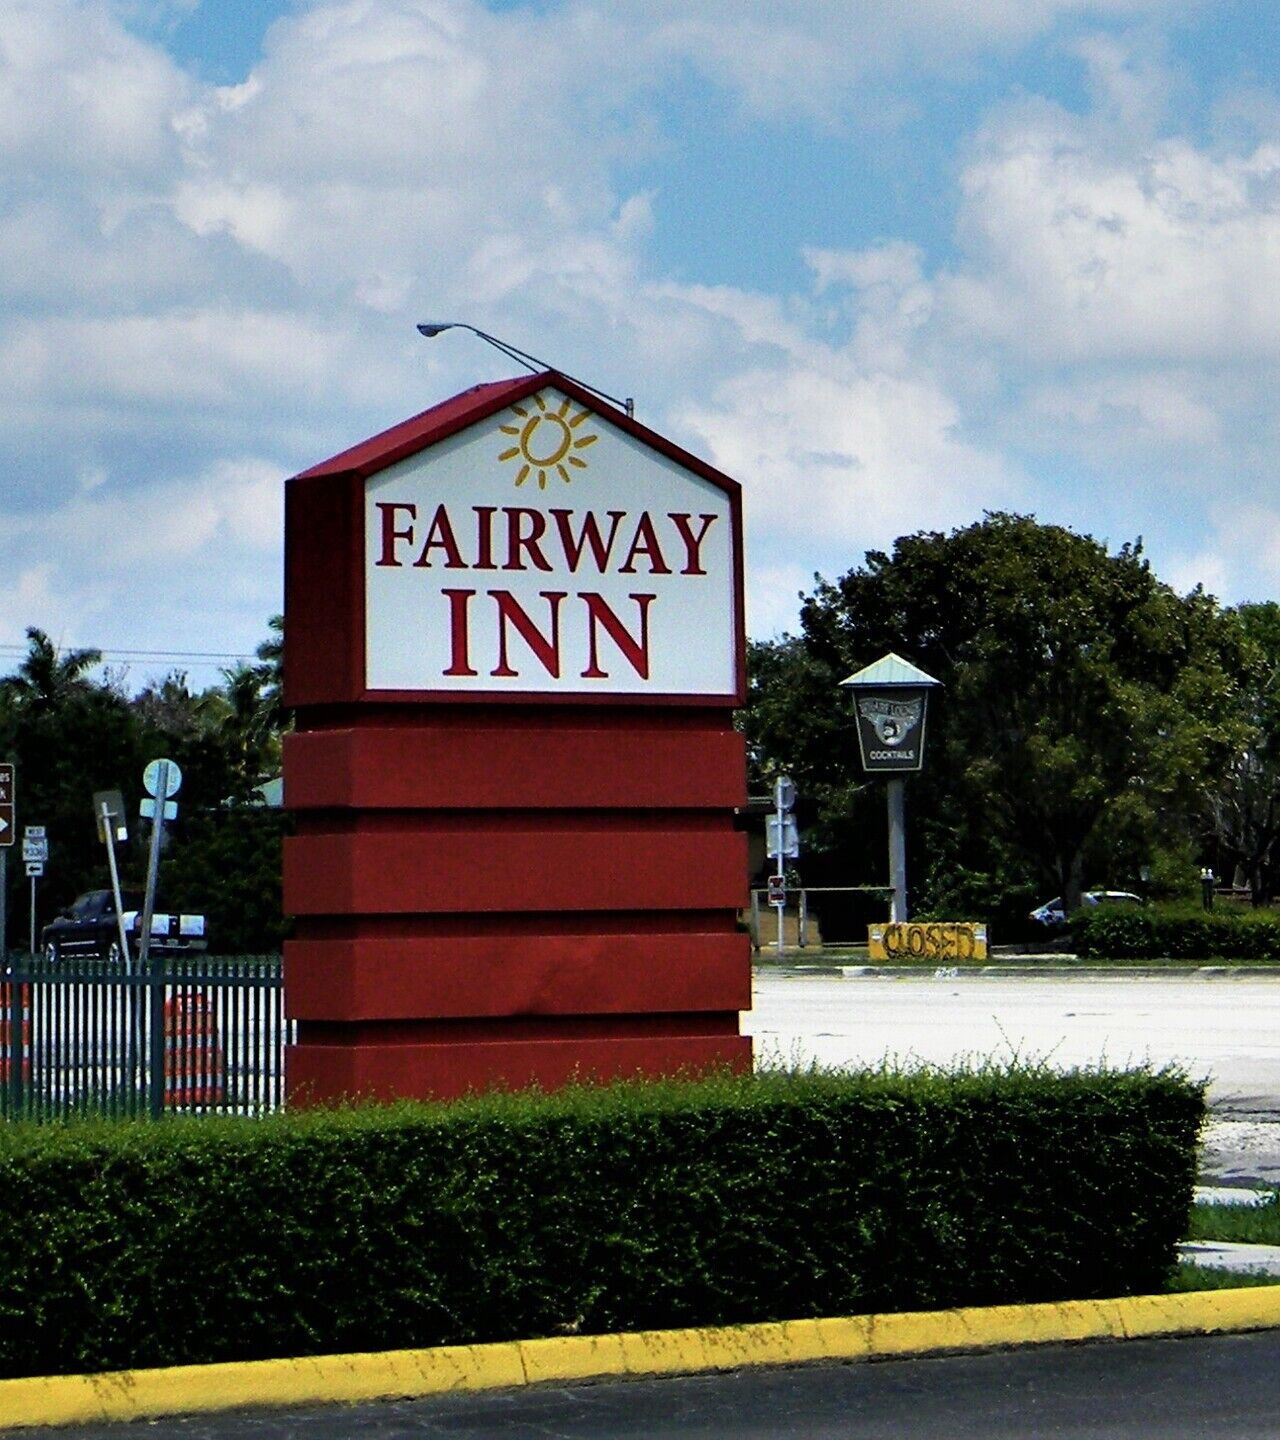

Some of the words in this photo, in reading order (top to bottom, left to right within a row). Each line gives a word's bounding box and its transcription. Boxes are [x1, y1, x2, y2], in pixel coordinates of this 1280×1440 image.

[375, 502, 718, 575] FAIRWAY
[442, 588, 656, 680] INN
[869, 749, 915, 760] COCKTAILS
